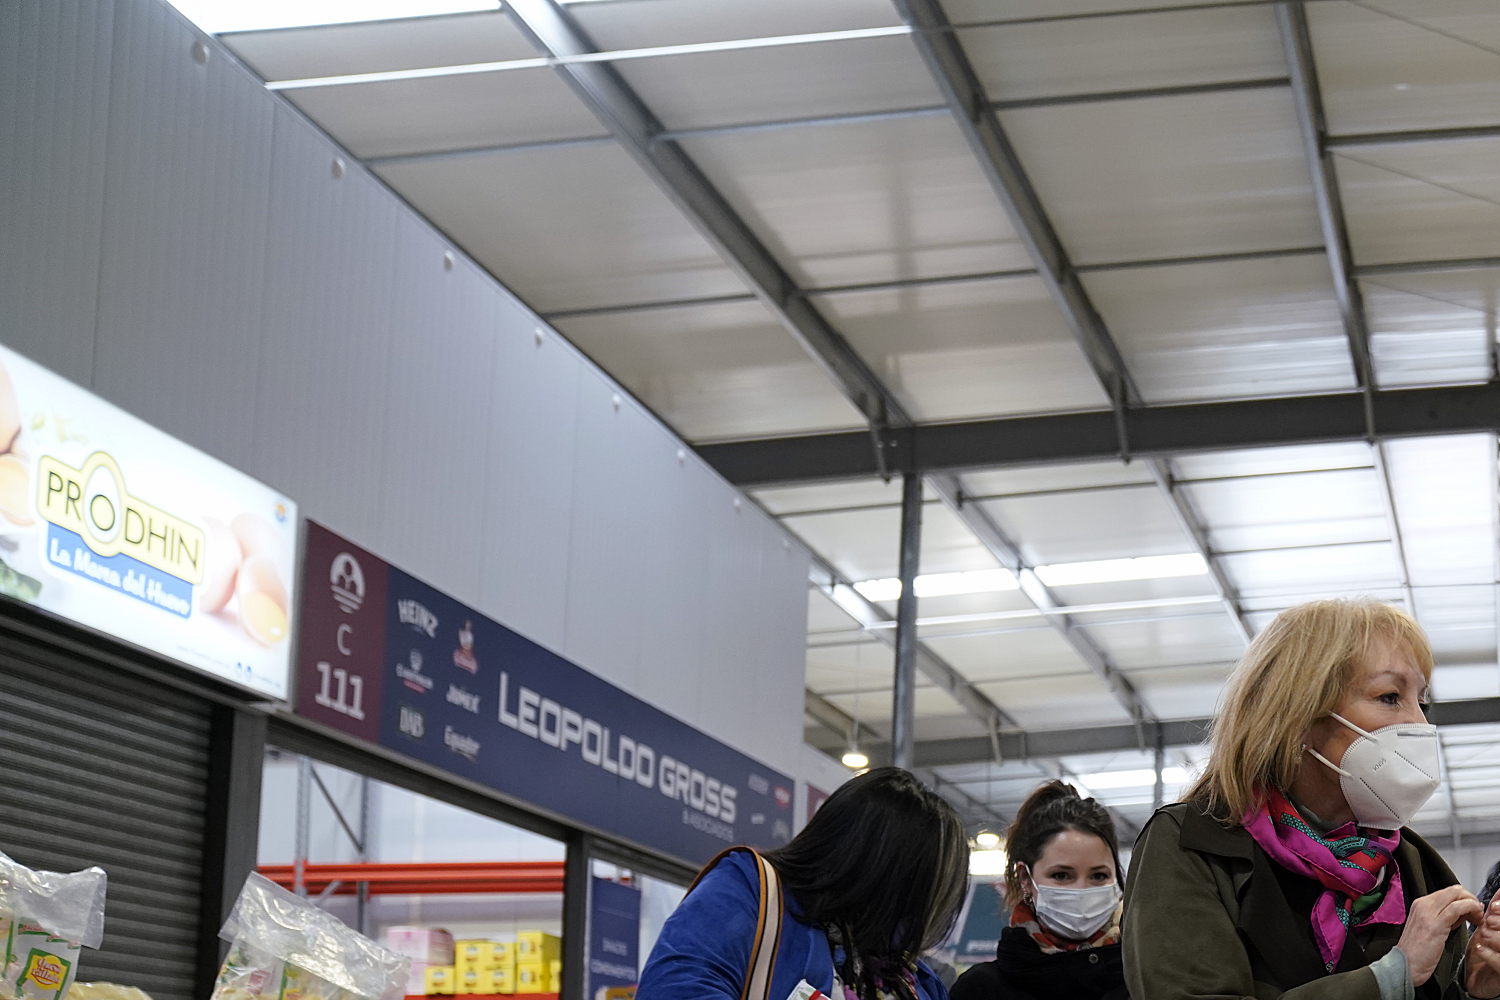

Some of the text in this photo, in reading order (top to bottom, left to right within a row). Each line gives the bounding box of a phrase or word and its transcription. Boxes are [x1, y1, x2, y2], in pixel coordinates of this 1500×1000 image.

[46, 470, 200, 571] PRODHIN
[50, 537, 71, 567] La
[336, 622, 353, 657] C
[398, 599, 438, 638] HEINZ
[315, 660, 365, 721] 111
[498, 670, 739, 826] LEOPOLDO GROSS
